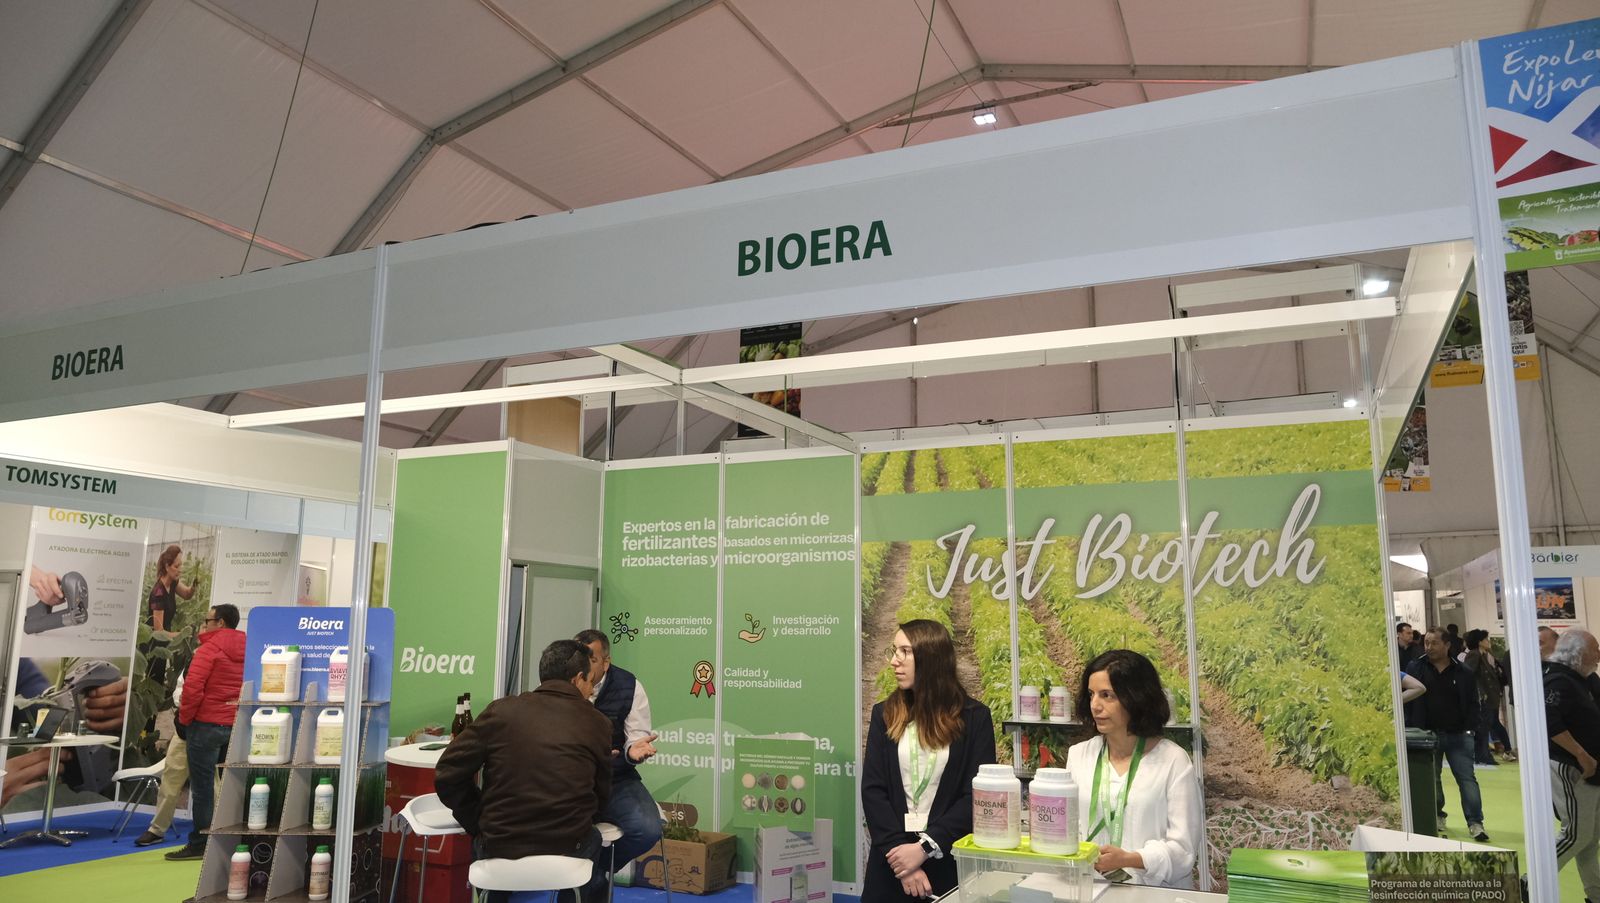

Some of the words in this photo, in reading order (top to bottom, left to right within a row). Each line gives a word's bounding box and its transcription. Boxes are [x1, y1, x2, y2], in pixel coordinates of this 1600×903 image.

[1508, 73, 1593, 109] Níjar
[738, 220, 892, 276] BIOERA
[52, 344, 123, 380] BIOERA
[6, 465, 117, 494] TOMSYSTEM
[48, 506, 138, 529] tomsystem
[622, 520, 682, 535] Expertos
[684, 521, 701, 531] en
[704, 517, 716, 530] la
[725, 512, 808, 529] fabricación
[810, 512, 830, 525] de
[622, 535, 718, 551] fertilizantes
[723, 536, 771, 547] basados
[773, 537, 788, 546] en
[926, 517, 1057, 600] Just
[1075, 483, 1327, 598] Biotech
[621, 553, 708, 567] rizobacterias
[710, 555, 719, 568] y
[724, 548, 856, 566] microorganismos
[298, 617, 344, 630] Bioera
[644, 616, 713, 625] Asesoramiento
[773, 615, 840, 626] Investigación
[644, 626, 708, 637] personalizado
[773, 628, 778, 637] y
[781, 626, 832, 635] desarrollo
[399, 646, 475, 675] Bioera
[724, 667, 761, 677] Calidad
[762, 669, 769, 679] y
[724, 679, 802, 689] responsabilidad
[686, 732, 715, 745] sea
[642, 753, 691, 768] emos
[694, 755, 715, 769] un
[983, 808, 994, 816] DS
[1038, 813, 1055, 823] SOL
[1371, 880, 1417, 888] Programa
[1419, 879, 1431, 888] de
[1433, 879, 1484, 888] alternativa
[1494, 879, 1502, 888] la
[1431, 889, 1470, 901] química
[1471, 889, 1506, 901] (PADQ)
